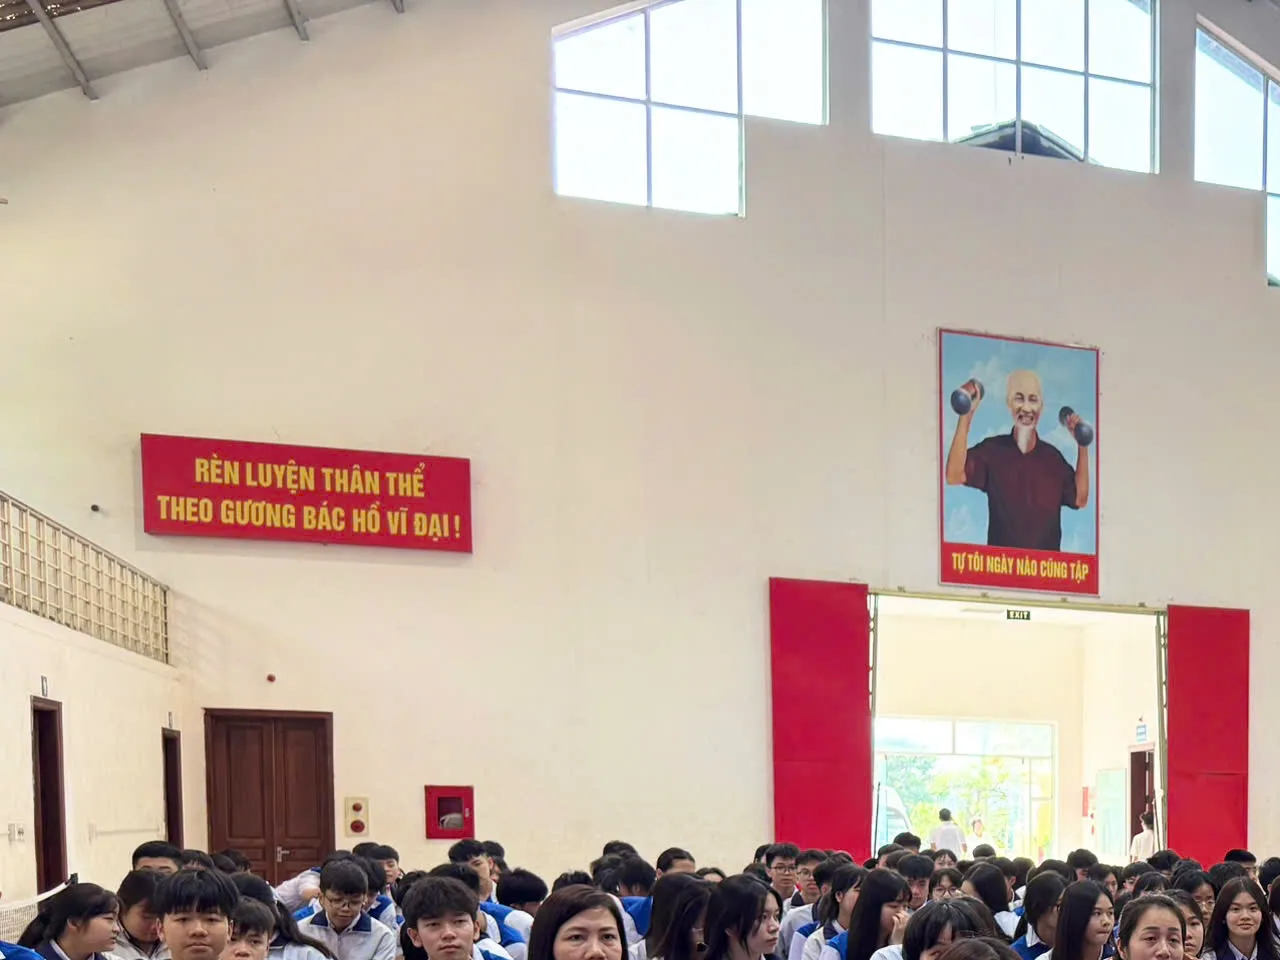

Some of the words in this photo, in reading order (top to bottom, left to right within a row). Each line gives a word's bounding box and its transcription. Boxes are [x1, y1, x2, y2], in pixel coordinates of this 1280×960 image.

[195, 453, 239, 485] RÈN
[246, 460, 315, 495] LUYỆN
[321, 465, 379, 495] THÂN
[386, 462, 424, 498] THỂ
[157, 495, 213, 523] THEO
[221, 499, 295, 528] GƯƠNG
[303, 501, 345, 531] BÁC
[353, 500, 380, 533] HỒ
[387, 507, 407, 535] VĨ
[414, 513, 449, 541] ĐẠI
[952, 552, 966, 574] TỰ
[968, 550, 983, 572] TÔI
[987, 553, 1013, 575] NGÀY
[1017, 555, 1037, 576] NÀO
[1040, 557, 1067, 578] CŨNG
[1070, 560, 1089, 583] TẬP
